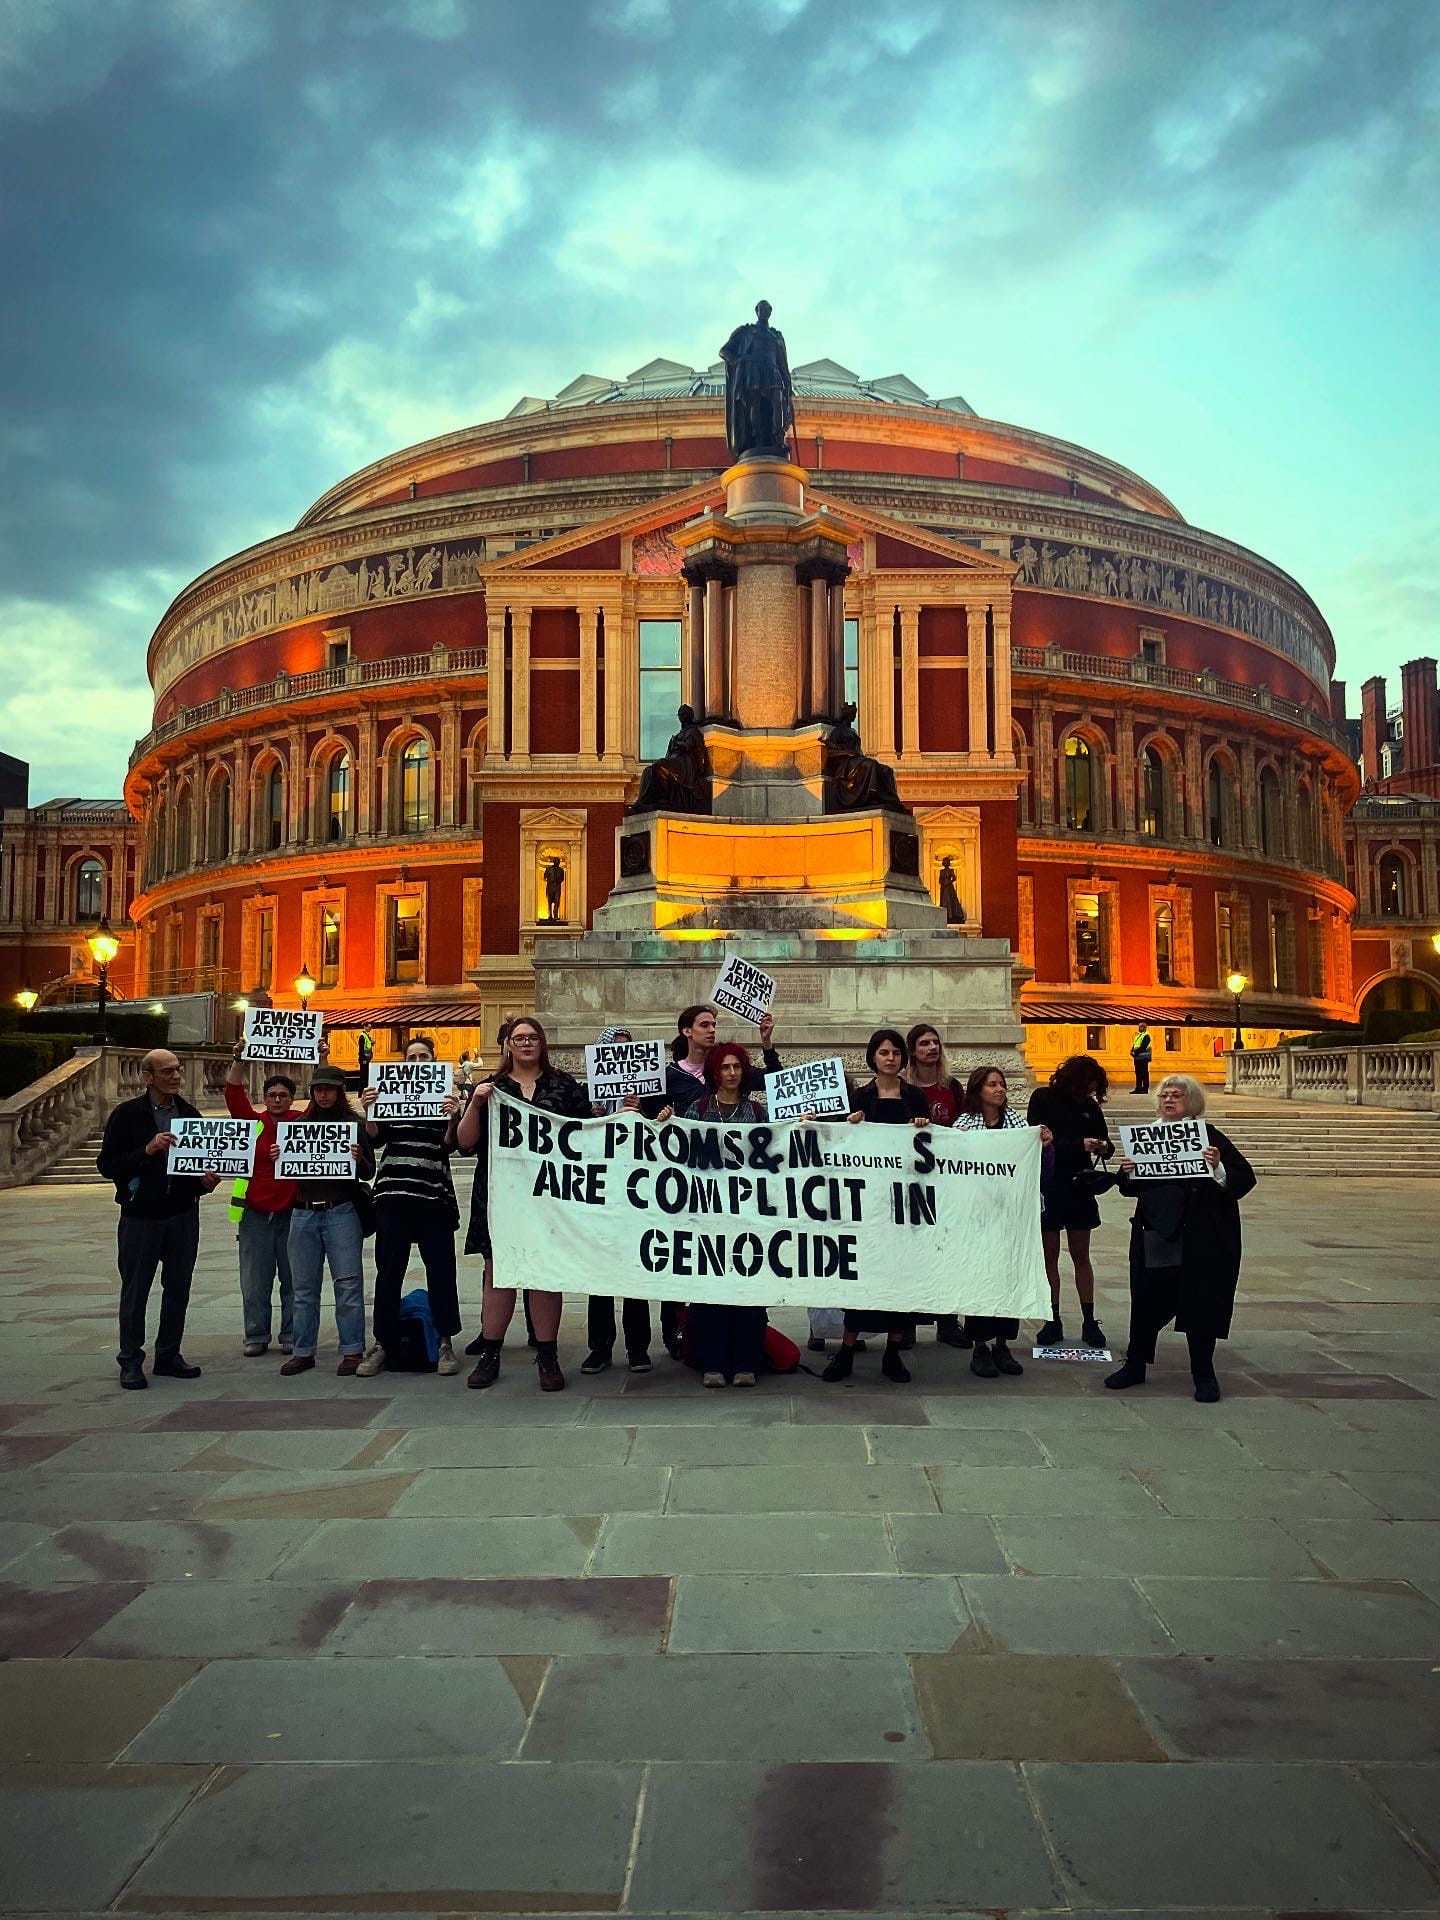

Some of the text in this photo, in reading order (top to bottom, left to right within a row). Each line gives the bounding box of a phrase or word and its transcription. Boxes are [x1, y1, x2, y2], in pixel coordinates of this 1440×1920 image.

[728, 958, 774, 994] JEWISH
[723, 972, 770, 1006] ARTISTS
[741, 993, 752, 1003] FOR
[716, 991, 766, 1024] PALESTINE
[252, 1010, 317, 1027] JEWISH
[251, 1025, 315, 1040] ARTISTS
[250, 1045, 313, 1059] PALESTINE
[594, 1042, 659, 1063] JEWISH
[376, 1064, 446, 1081] JEWISH
[594, 1058, 660, 1076] ARTISTS
[774, 1061, 837, 1089] JEWISH
[622, 1073, 637, 1081] FOR
[378, 1080, 446, 1095] ARTISTS
[597, 1080, 659, 1097] PALESTINE
[775, 1076, 840, 1100] ARTISTS
[405, 1094, 420, 1102] FOR
[802, 1093, 817, 1101] FOR
[377, 1103, 443, 1117] PALESTINE
[777, 1097, 842, 1118] PALESTINE
[178, 1120, 251, 1137] JEWISH
[283, 1124, 351, 1140] JEWISH
[1130, 1121, 1200, 1143] JEWISH
[178, 1136, 250, 1151] ARTISTS
[283, 1140, 351, 1153] ARTISTS
[498, 1102, 583, 1162] BBC
[913, 1131, 1017, 1177] SYMPHONY
[1132, 1138, 1203, 1155] ARTISTS
[207, 1150, 224, 1158] FOR
[177, 1158, 246, 1173] PALESTINE
[284, 1162, 349, 1175] PALESTINE
[1136, 1160, 1206, 1176] PALESTINE
[532, 1159, 937, 1226] ARE COMPLICIT IN
[639, 1228, 859, 1281] GENOCIDE
